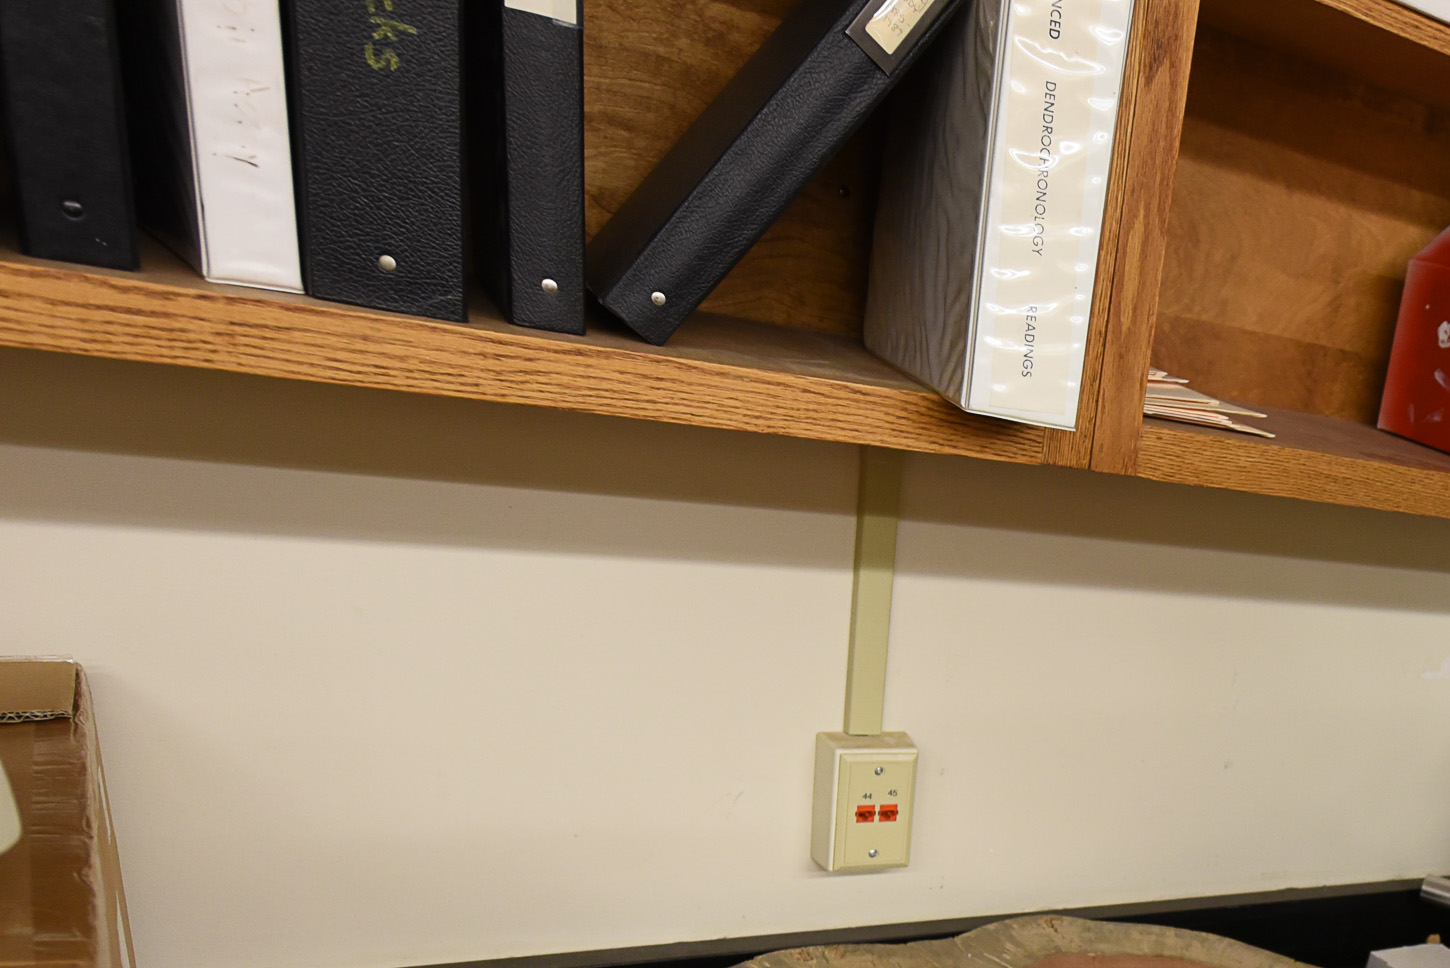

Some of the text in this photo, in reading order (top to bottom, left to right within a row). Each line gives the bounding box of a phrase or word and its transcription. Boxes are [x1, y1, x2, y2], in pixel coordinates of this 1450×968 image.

[1031, 81, 1057, 256] DENDROCHRONOLOGY
[1021, 306, 1038, 378] READINGS
[862, 789, 898, 800] 44 45
